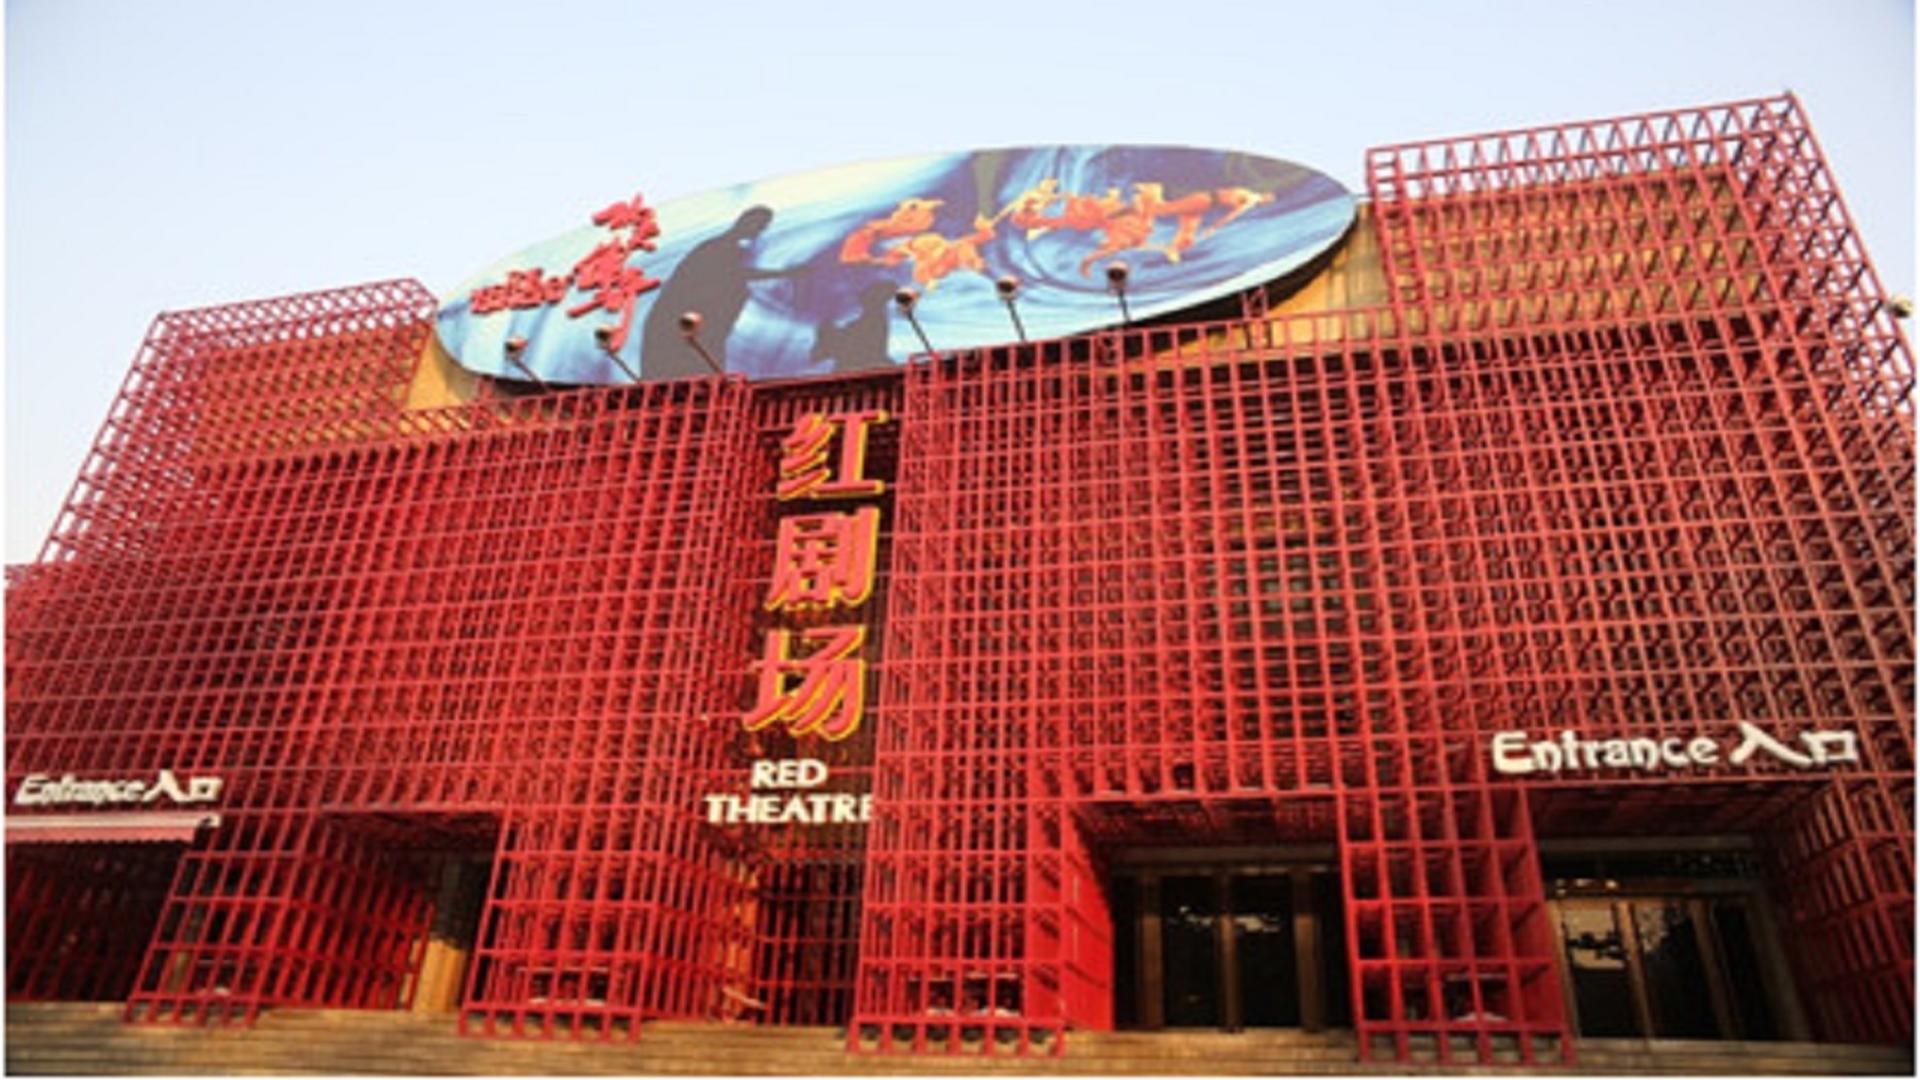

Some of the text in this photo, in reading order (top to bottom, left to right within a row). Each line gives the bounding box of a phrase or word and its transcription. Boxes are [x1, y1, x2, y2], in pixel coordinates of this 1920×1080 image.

[742, 410, 890, 743] 红剧场
[1491, 719, 1859, 774] Entrance 入口
[14, 769, 224, 806] Entrance 入口
[752, 758, 828, 790] RED
